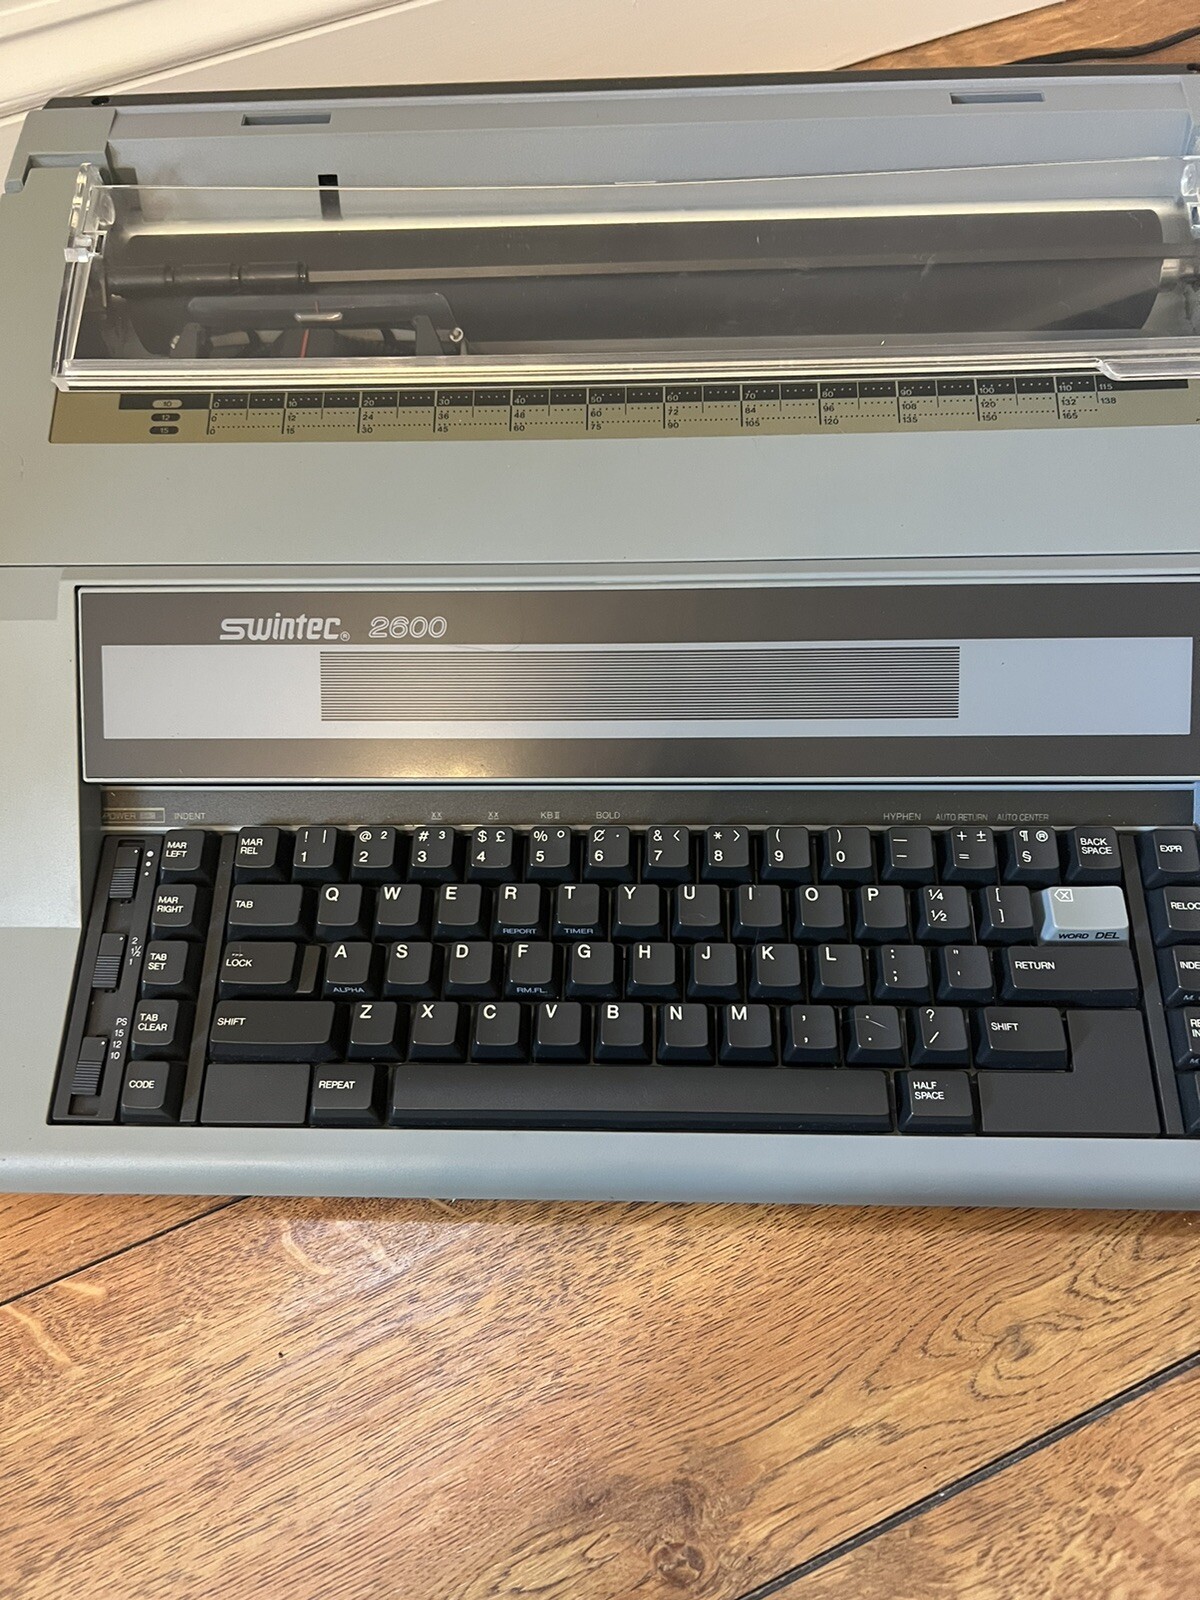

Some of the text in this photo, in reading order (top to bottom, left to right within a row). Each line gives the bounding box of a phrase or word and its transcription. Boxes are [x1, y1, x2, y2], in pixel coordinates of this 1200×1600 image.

[369, 616, 447, 638] 2600
[359, 831, 372, 842] @
[419, 830, 429, 841] #
[478, 830, 505, 843] $ £
[534, 831, 548, 841] %
[653, 830, 662, 841] &
[301, 852, 306, 862] 1
[360, 851, 368, 862] 2
[418, 851, 426, 862] 3
[477, 851, 485, 862] 4
[536, 851, 544, 862] 5
[595, 850, 604, 862] 6
[654, 851, 663, 861] 7
[714, 850, 723, 862] 8
[774, 851, 784, 862] 9
[836, 851, 845, 862] 0
[325, 887, 339, 901] Q
[384, 887, 401, 900] W
[446, 887, 458, 900] E
[505, 887, 517, 900] R
[564, 886, 576, 899] T
[624, 886, 636, 899] Y
[684, 886, 695, 900] U
[749, 887, 752, 900] I
[805, 887, 818, 901] O
[868, 888, 879, 901] P
[334, 945, 347, 958] A
[396, 944, 408, 958] S
[456, 945, 468, 958] D
[518, 944, 529, 958] F
[578, 944, 591, 958] G
[639, 945, 650, 958] H
[702, 946, 710, 959] J
[762, 946, 774, 960] K
[826, 947, 836, 960] L
[1015, 961, 1055, 970] RETURN
[360, 1005, 372, 1018] Z
[421, 1004, 434, 1018] X
[483, 1004, 496, 1019] C
[546, 1004, 557, 1018] V
[607, 1005, 619, 1019] B
[670, 1006, 682, 1020] N
[731, 1006, 747, 1020] M
[991, 1022, 1018, 1031] SHIFT
[129, 1080, 155, 1088] CODE
[319, 1081, 355, 1089] REPEAT
[915, 1092, 944, 1100] SPACE
